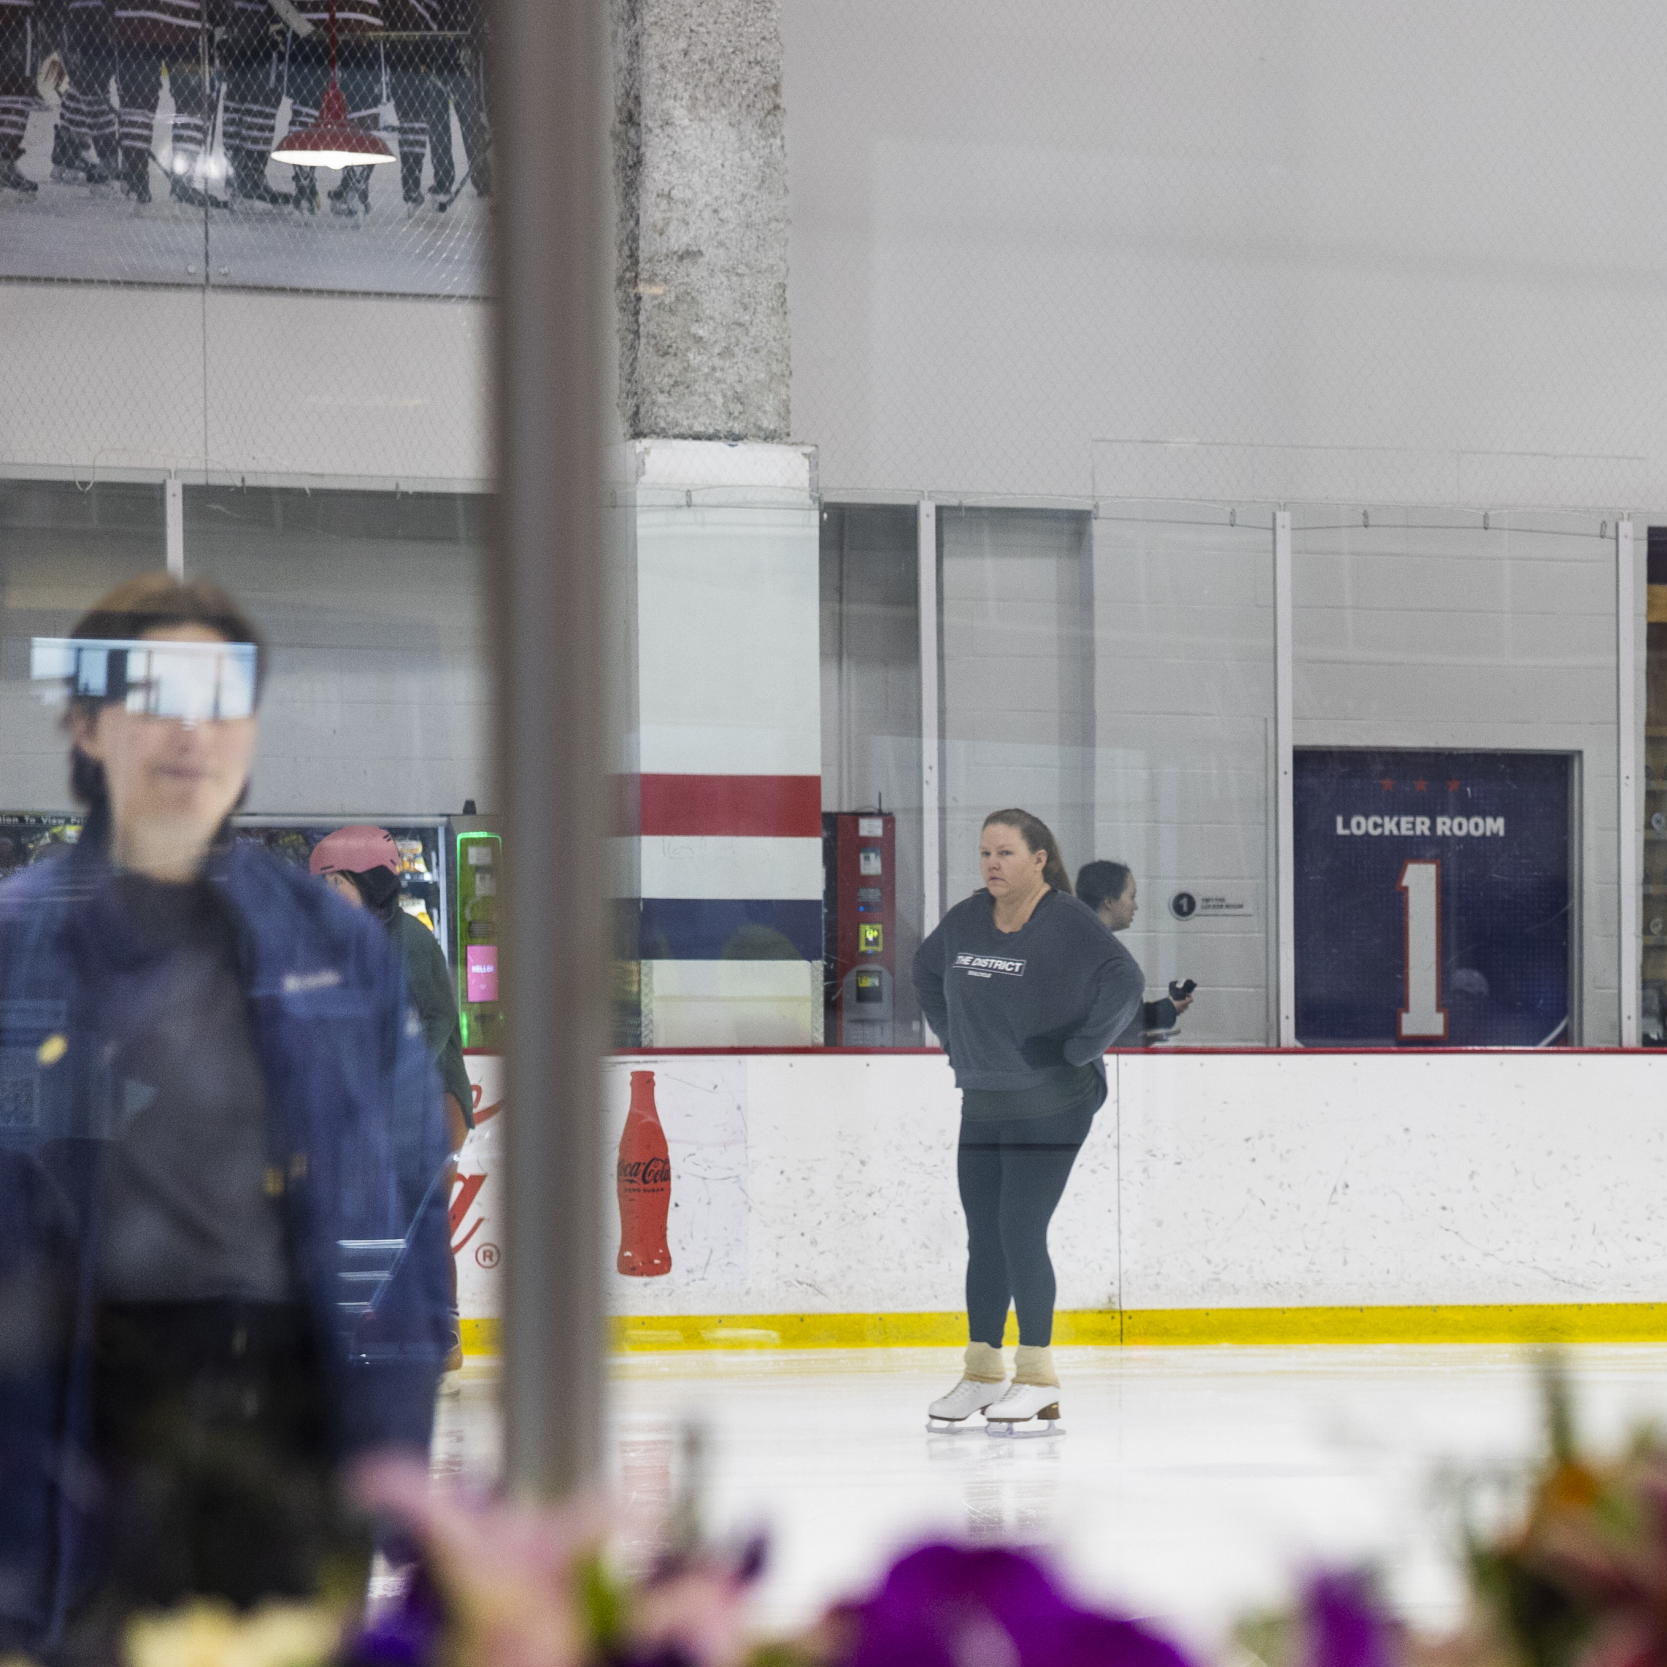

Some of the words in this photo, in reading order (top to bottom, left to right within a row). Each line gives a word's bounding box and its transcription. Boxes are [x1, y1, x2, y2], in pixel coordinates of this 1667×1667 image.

[1336, 815, 1430, 836] LOCKER
[1436, 816, 1506, 837] ROOM
[1396, 859, 1449, 1041] 1
[971, 957, 1023, 973] DISTRICT
